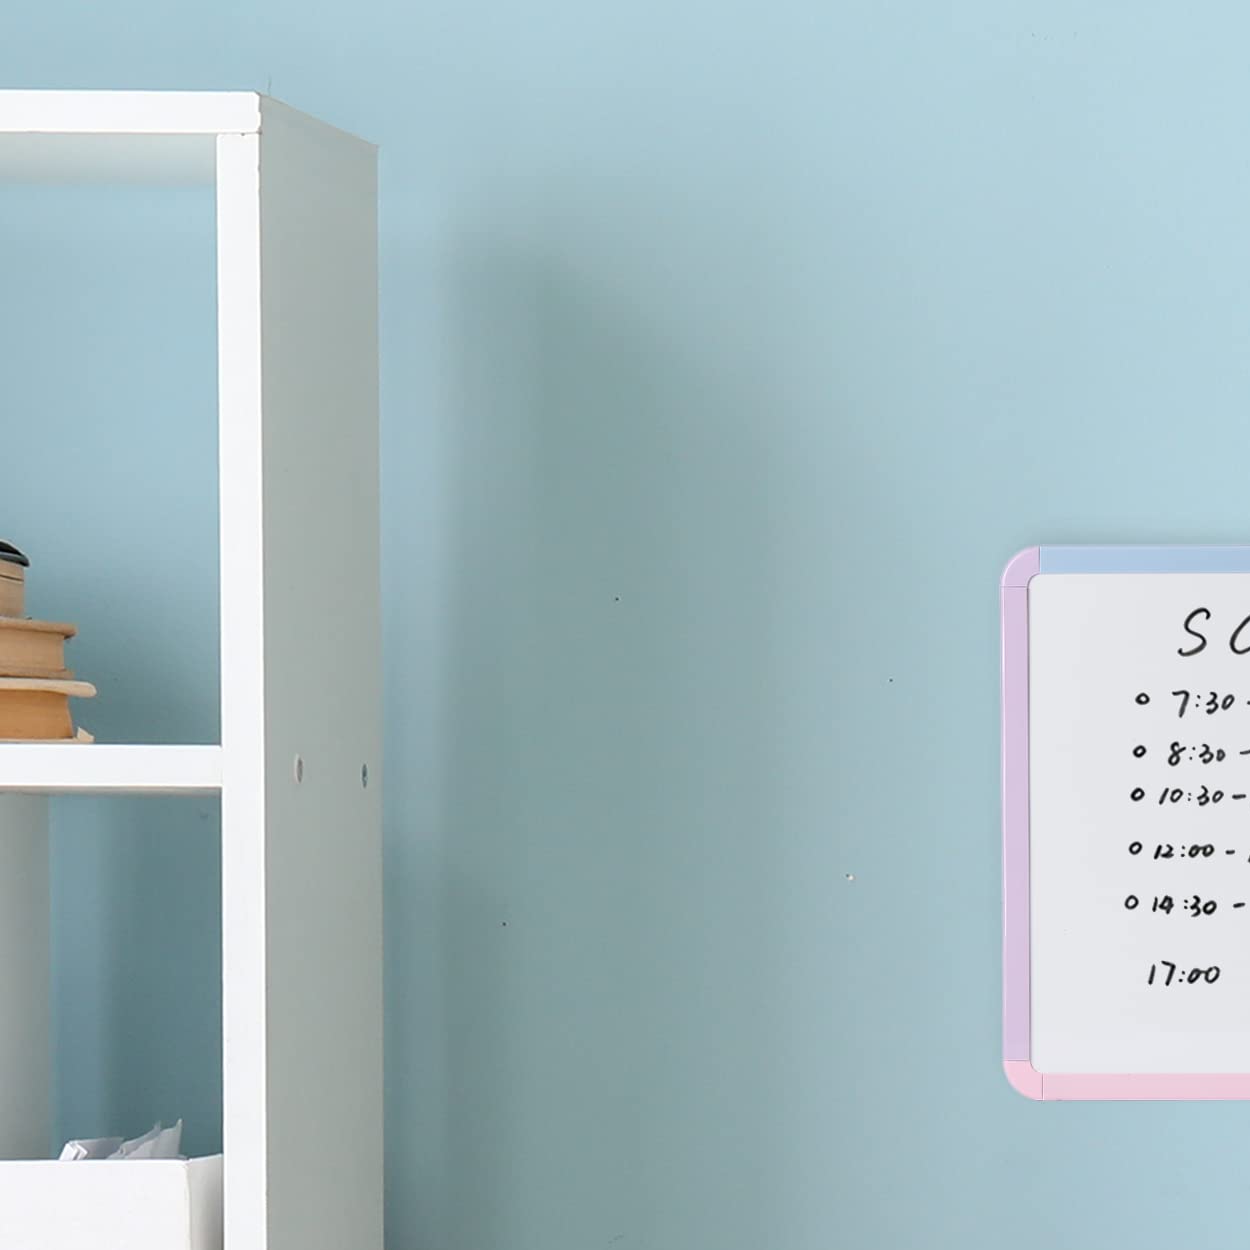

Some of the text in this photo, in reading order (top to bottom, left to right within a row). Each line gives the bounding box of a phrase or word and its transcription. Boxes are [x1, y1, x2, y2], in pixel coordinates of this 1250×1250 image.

[1171, 689, 1236, 719] 7:30
[1167, 740, 1227, 767] 8:30
[1153, 843, 1216, 861] 12:00
[1151, 894, 1218, 918] 14:30
[1147, 960, 1221, 987] 17:00
